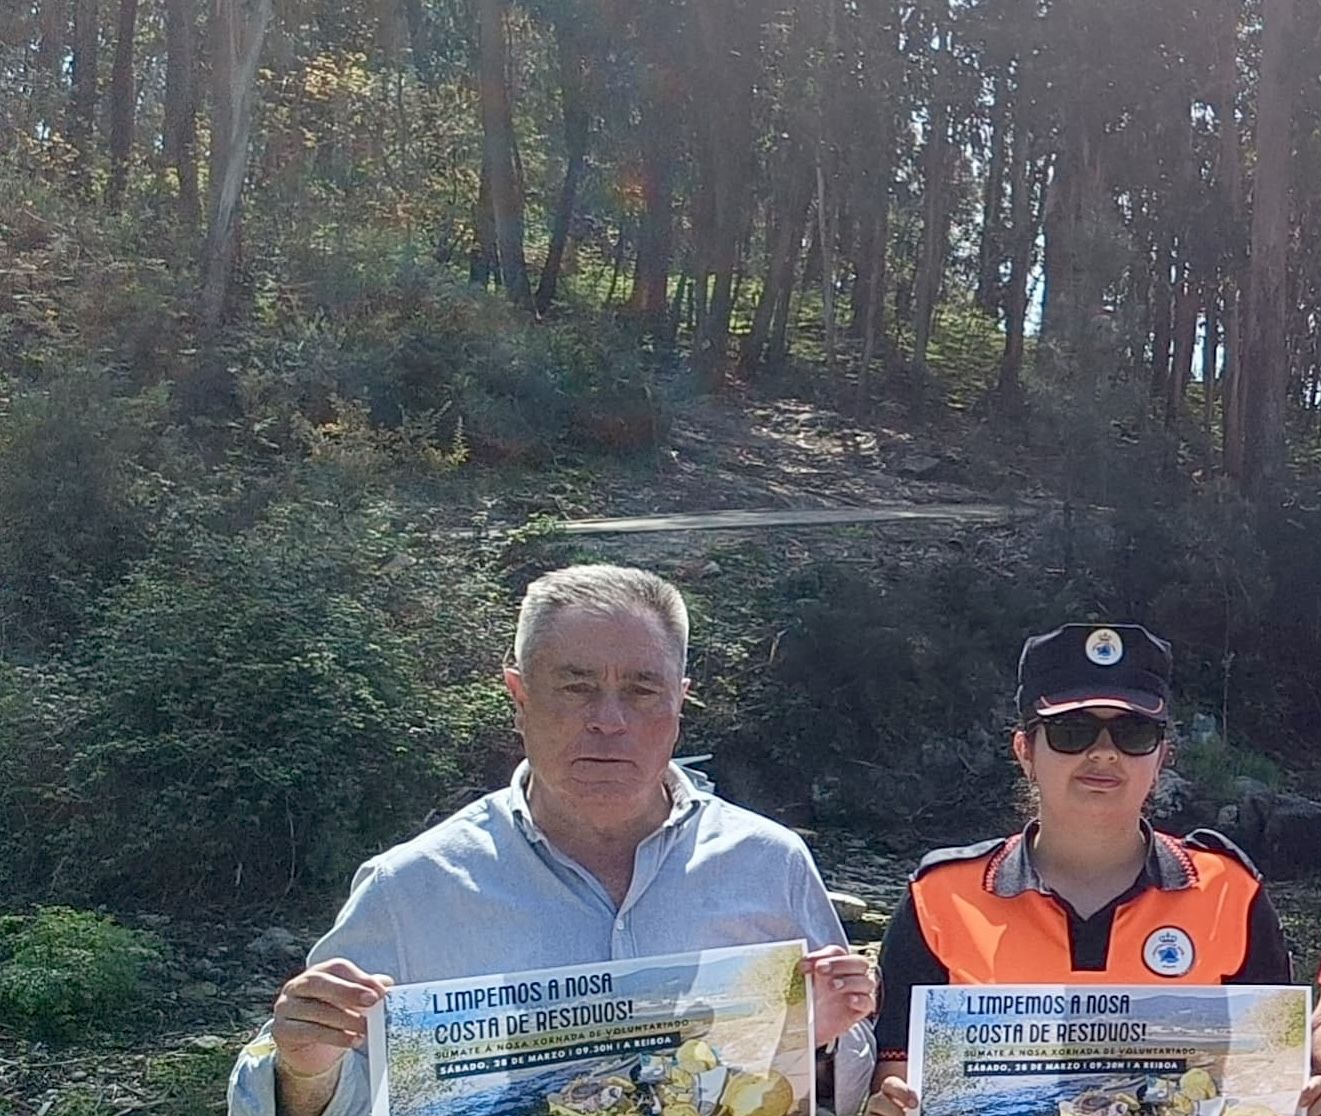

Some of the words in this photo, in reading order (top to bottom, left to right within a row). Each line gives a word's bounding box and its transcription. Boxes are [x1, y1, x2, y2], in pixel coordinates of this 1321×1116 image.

[433, 982, 542, 1014] LIMPEMOS
[548, 979, 559, 1000] A
[565, 973, 613, 998] NOSA
[967, 995, 1065, 1015] LIMPEMOS
[1071, 995, 1080, 1015] A
[1086, 994, 1129, 1014] NOSA
[435, 1017, 499, 1044] COSTA
[506, 1014, 530, 1035] DE
[536, 1000, 633, 1032] RESIDUOS!
[966, 1024, 1023, 1043] COSTA
[1029, 1024, 1050, 1043] DE
[1057, 1023, 1146, 1042] RESIDUOS!
[511, 1057, 524, 1065] DE
[528, 1050, 565, 1062] MARZO
[1031, 1063, 1042, 1071] DE
[1045, 1062, 1080, 1071] MARZO
